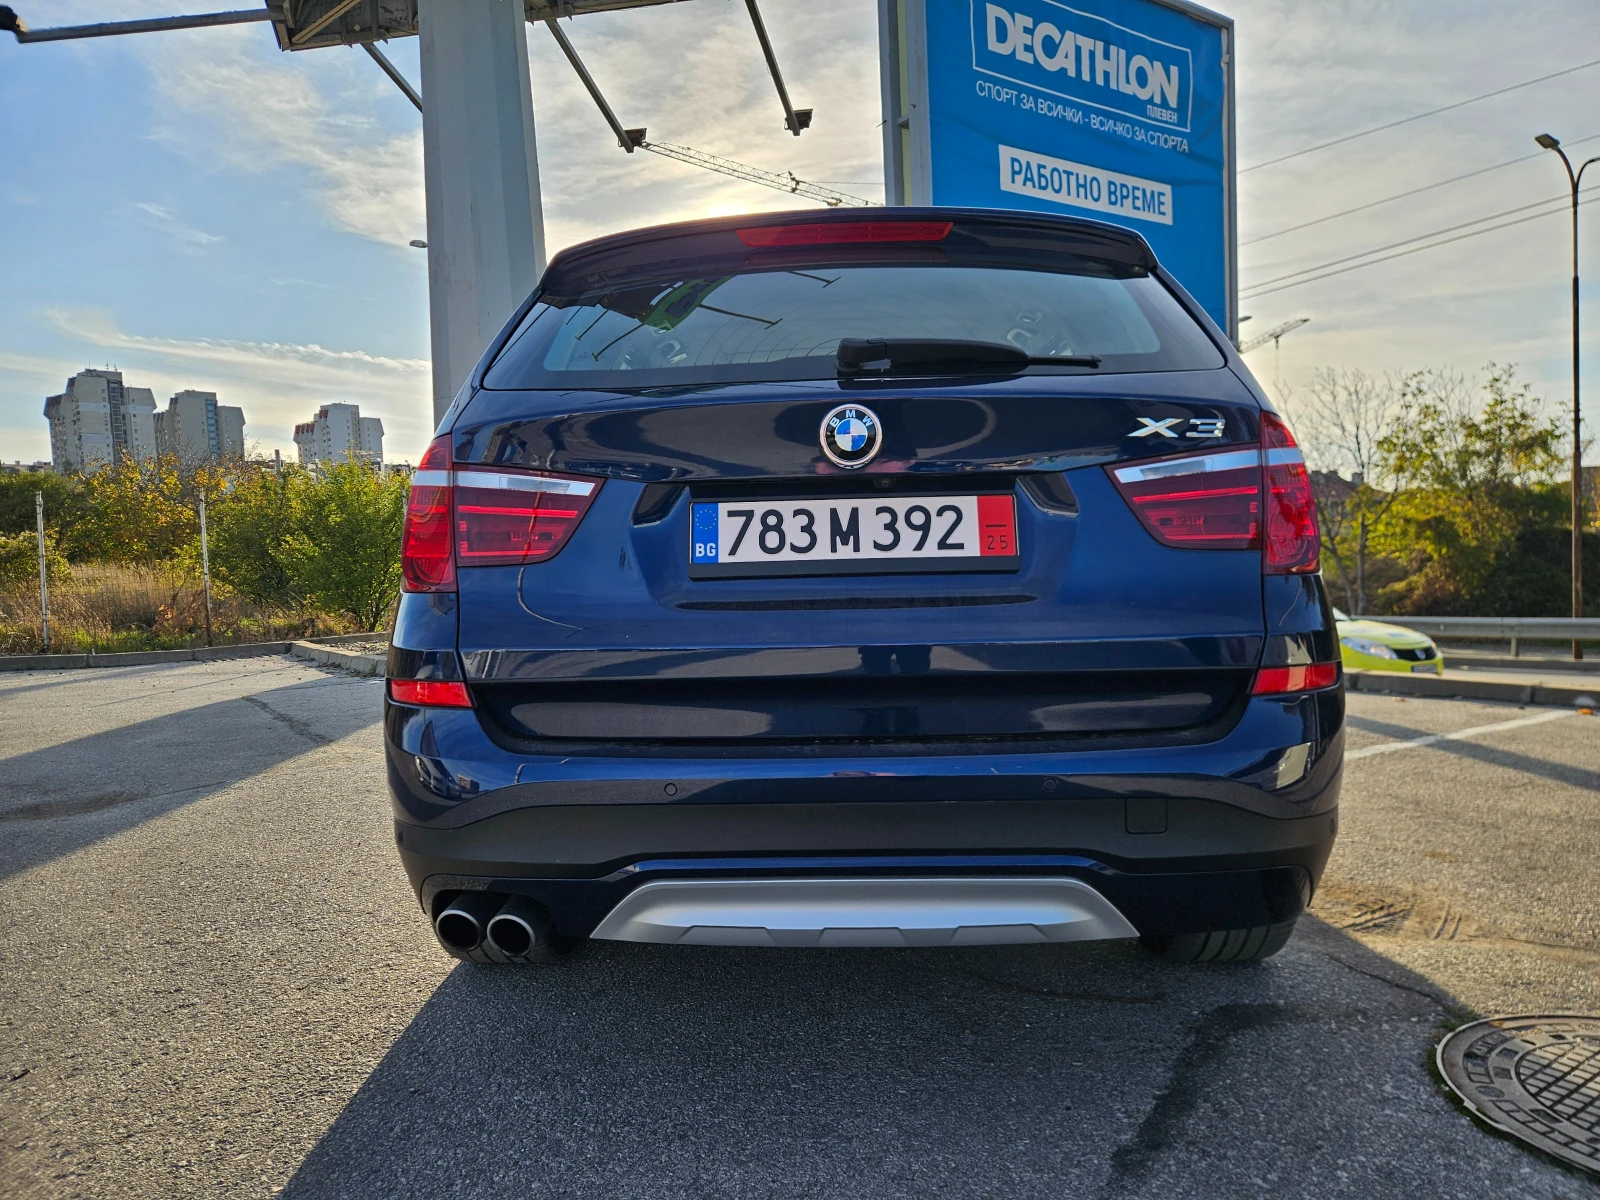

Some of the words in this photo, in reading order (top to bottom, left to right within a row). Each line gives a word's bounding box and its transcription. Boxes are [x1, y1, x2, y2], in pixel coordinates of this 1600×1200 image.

[986, 3, 1179, 108] DECATHLON
[976, 80, 1018, 106] СПОРТ
[1020, 93, 1036, 112] ЗА
[1037, 98, 1083, 125] ВСИЧКИ
[1090, 114, 1132, 138] ВСИЧКО
[1133, 126, 1147, 143] ЗА
[1147, 131, 1189, 153] СПОРТА
[1146, 104, 1178, 123] ПЛЕВЕН
[1010, 157, 1101, 202] РАБОТНО
[1108, 183, 1167, 216] ВРЕМЕ
[829, 410, 874, 428] BMW
[1126, 417, 1226, 438] X3
[727, 508, 818, 556] 783
[829, 506, 861, 553] M
[873, 504, 965, 551] 392
[695, 542, 717, 557] BG
[986, 535, 1008, 550] 25
